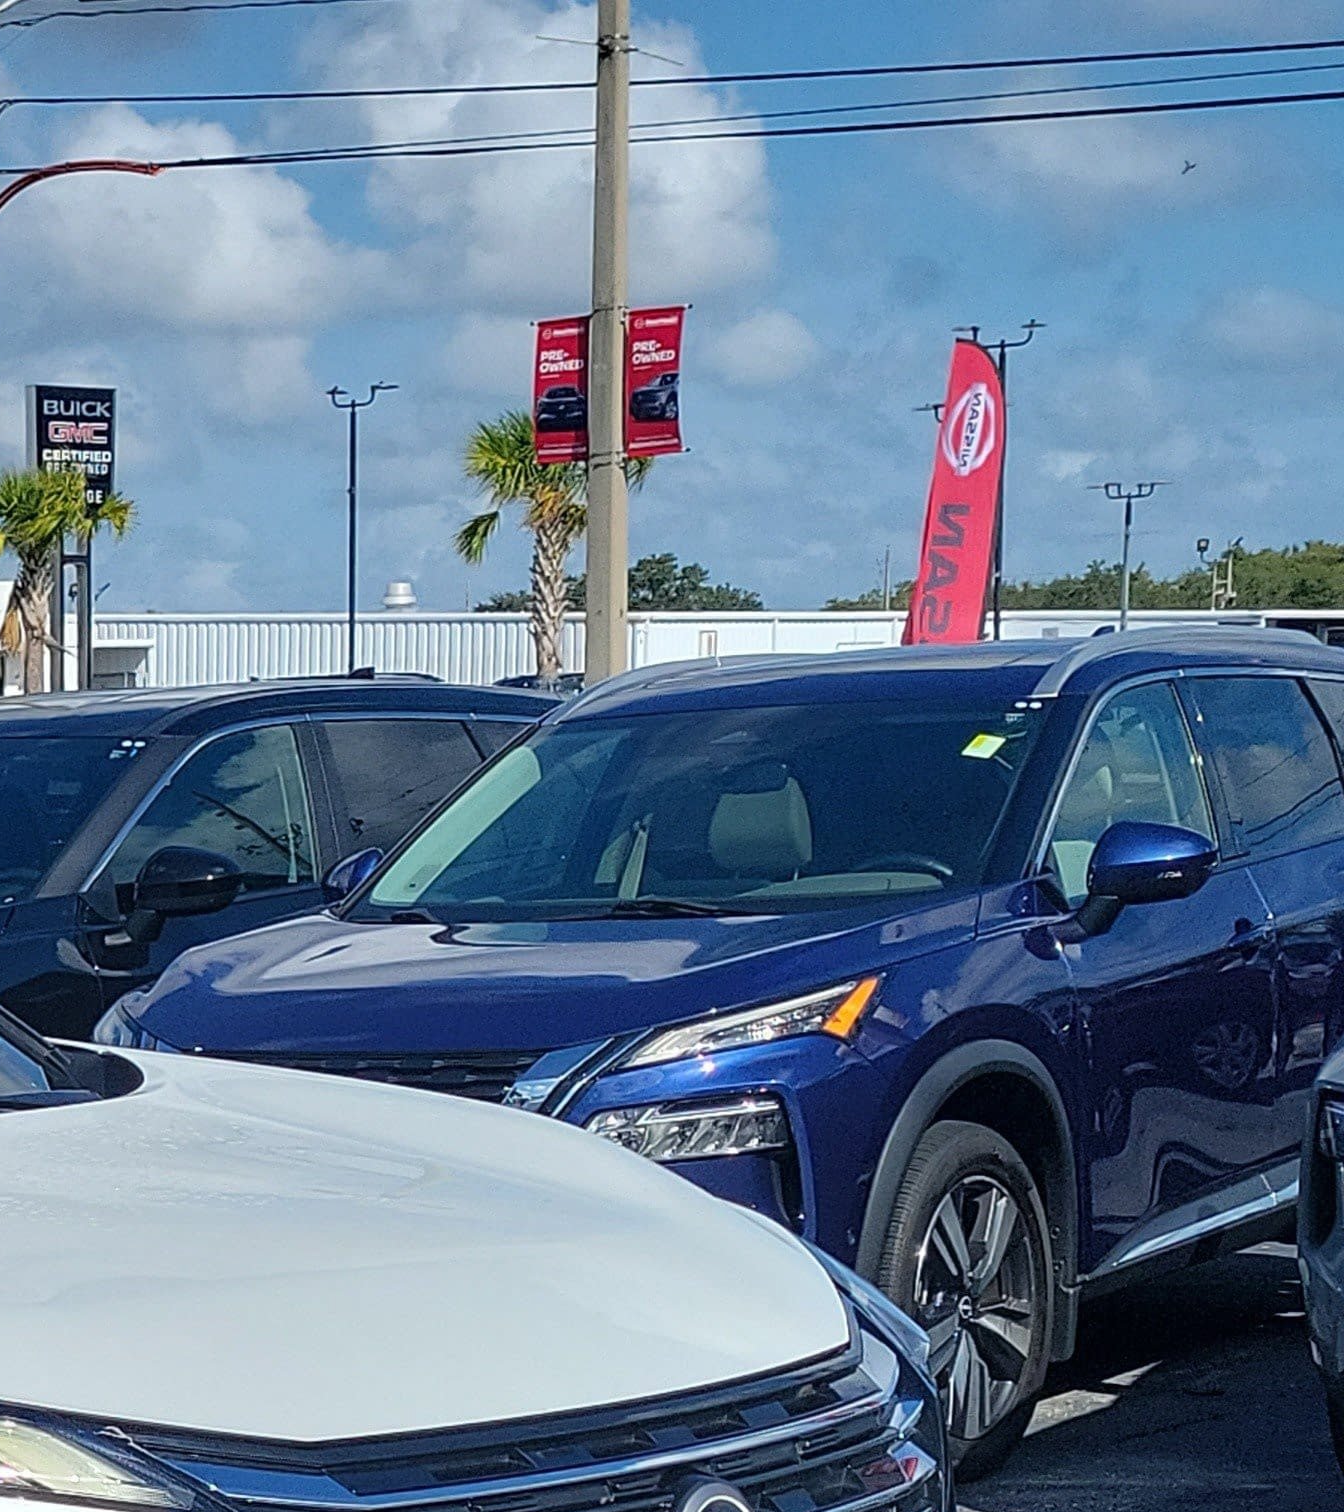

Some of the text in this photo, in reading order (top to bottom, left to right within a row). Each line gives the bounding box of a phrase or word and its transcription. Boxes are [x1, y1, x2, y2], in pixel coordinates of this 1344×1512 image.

[632, 340, 662, 352] PRE-
[540, 348, 570, 362] PRE-
[632, 350, 676, 365] OWNED
[539, 359, 585, 373] OWNED
[42, 398, 112, 418] BUICK
[47, 421, 109, 445] GMC
[42, 448, 113, 463] CERTIFIED
